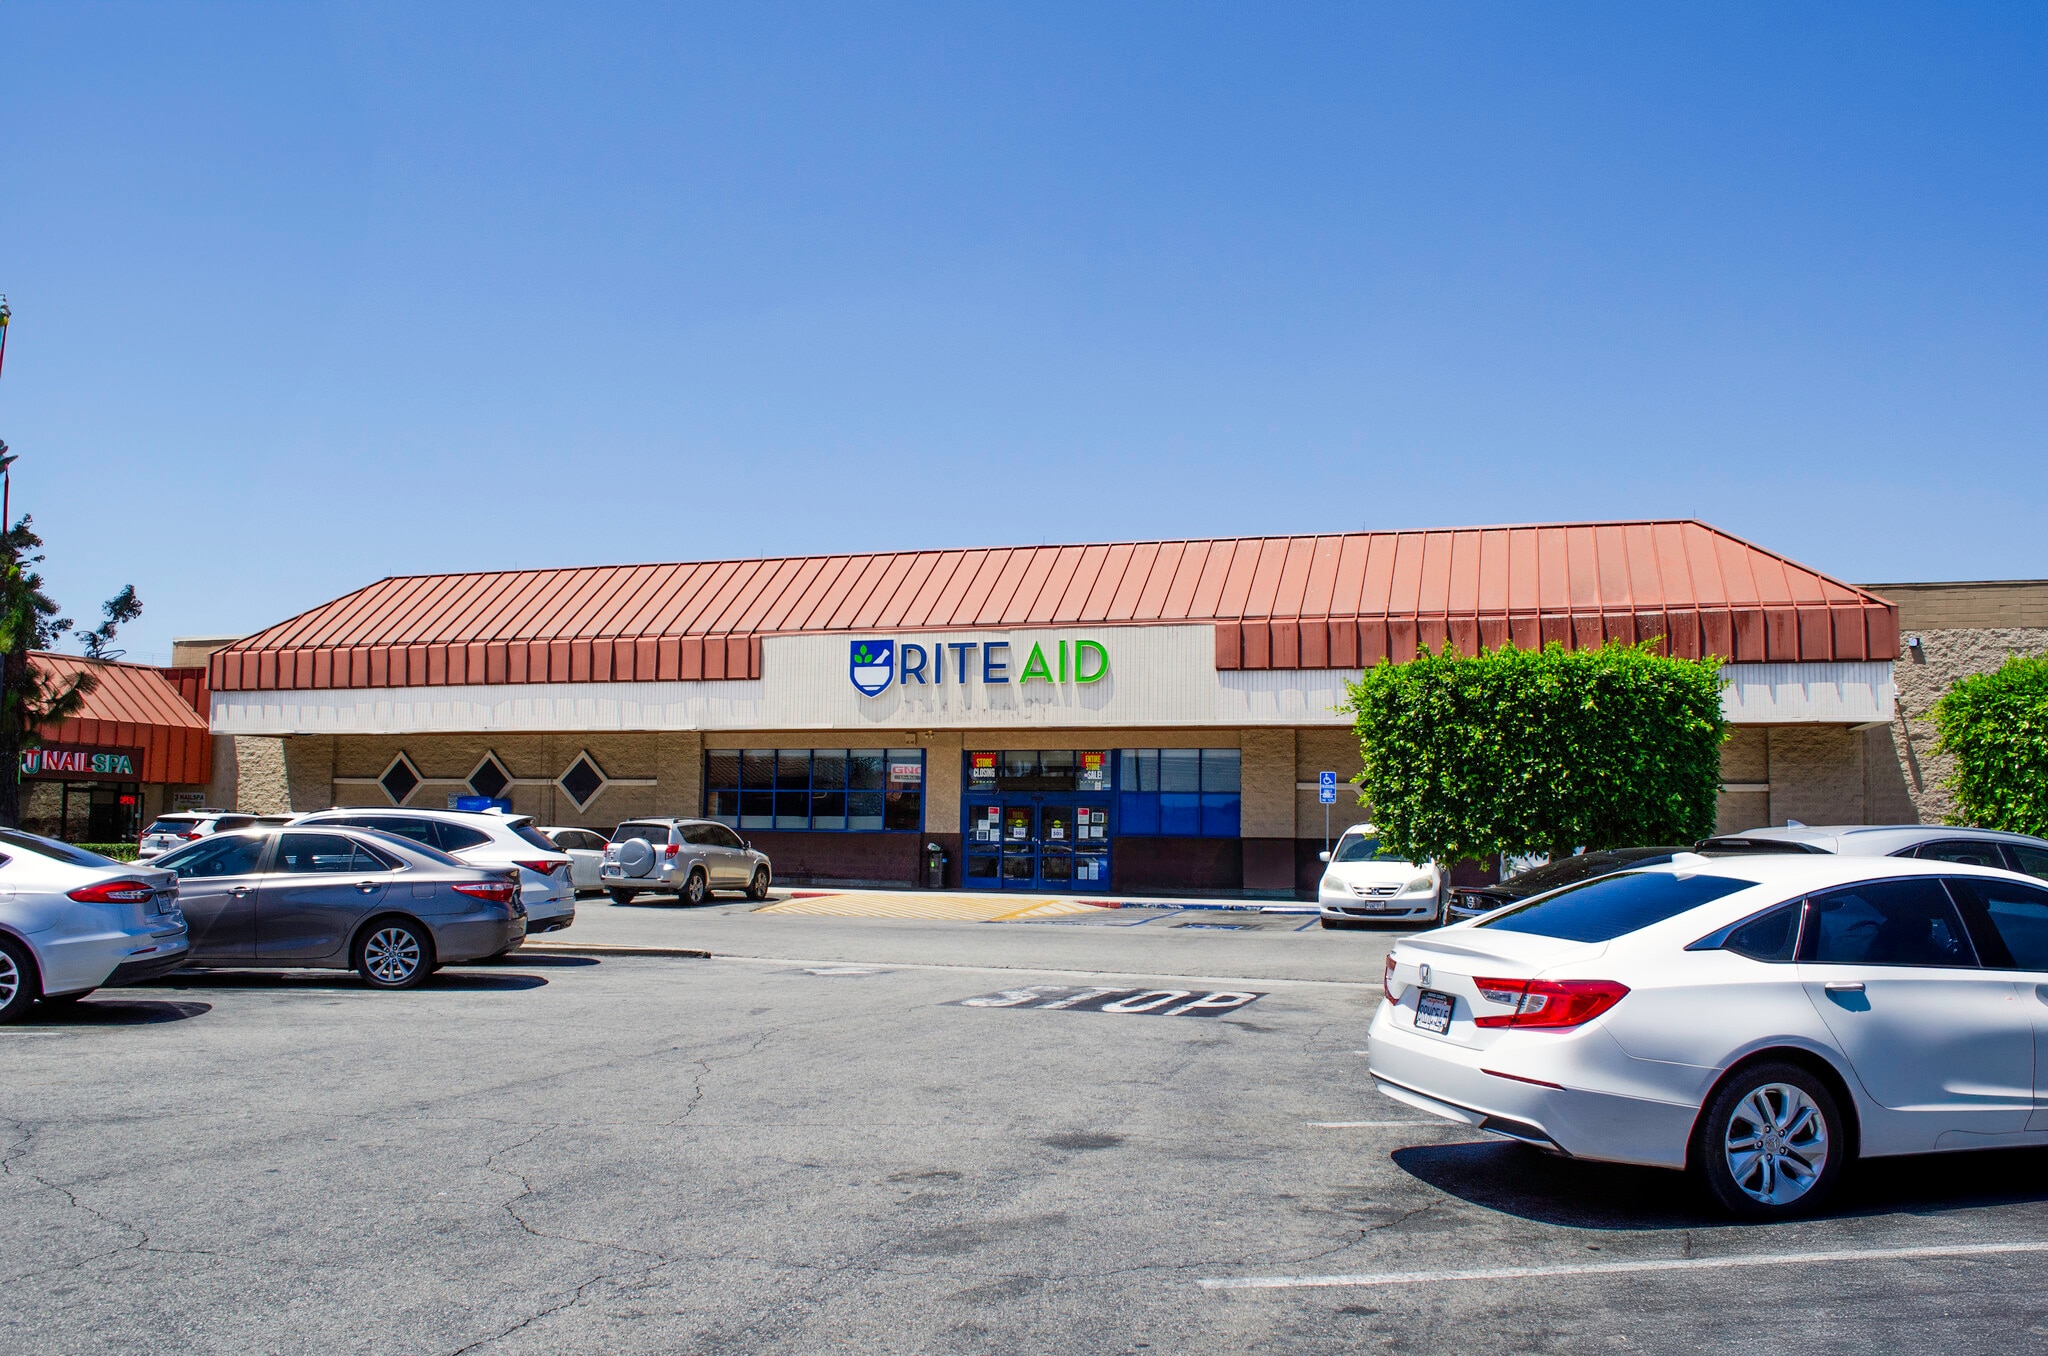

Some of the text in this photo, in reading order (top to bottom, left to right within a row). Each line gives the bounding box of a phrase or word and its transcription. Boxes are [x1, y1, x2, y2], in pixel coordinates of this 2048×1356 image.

[900, 639, 1110, 685] RITE AID
[42, 750, 93, 773] NAIL
[92, 753, 133, 775] SPA
[973, 768, 995, 778] CLOSING
[976, 758, 993, 767] STORE
[960, 985, 1257, 1017] STOP
